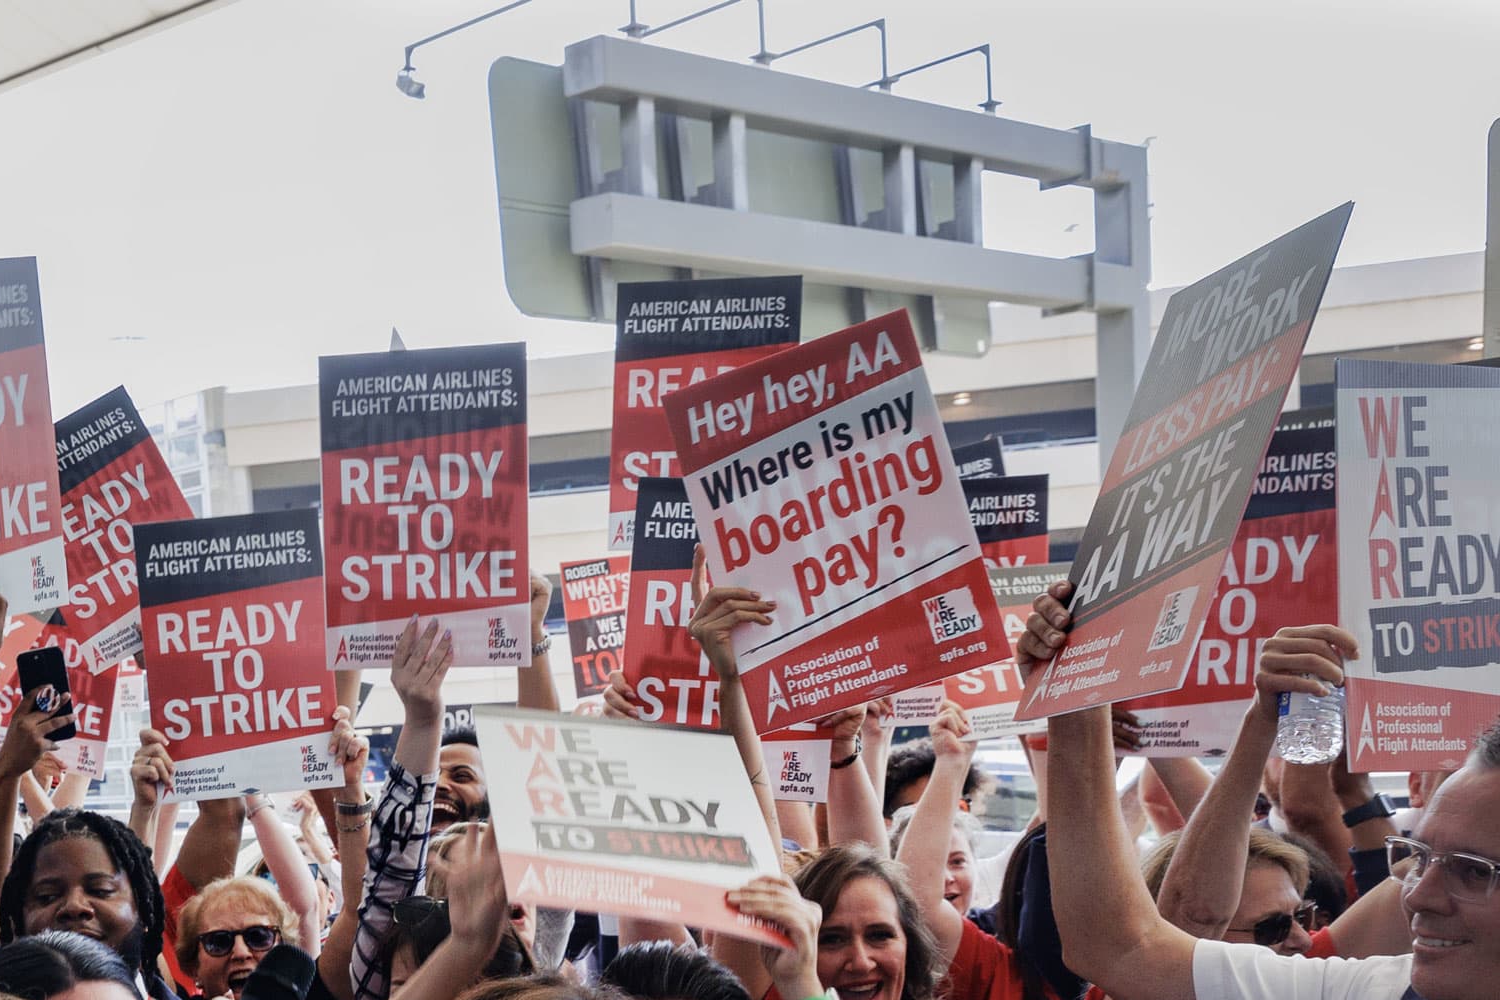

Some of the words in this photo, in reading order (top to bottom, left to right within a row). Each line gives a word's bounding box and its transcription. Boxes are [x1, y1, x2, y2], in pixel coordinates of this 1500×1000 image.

[629, 299, 711, 317] AMERICAN
[714, 296, 786, 313] AIRLINES
[1159, 251, 1268, 367] MORE
[624, 317, 679, 334] FLIGHT
[682, 314, 789, 332] ATTENDANTS:
[1198, 265, 1315, 384] WORK
[337, 374, 428, 396] AMERICAN
[432, 368, 512, 390] AIRLINES
[686, 392, 755, 446] Hey
[766, 363, 837, 415] hey,
[845, 332, 901, 383] AA
[332, 397, 390, 416] FLIGHT
[396, 389, 518, 414] ATTENDANTS:
[1123, 391, 1201, 476] LESS
[1200, 348, 1280, 426] PAY:
[70, 407, 126, 446] AIRLINES
[1358, 396, 1429, 458] WE
[700, 439, 814, 511] Where
[818, 421, 853, 458] is
[861, 390, 915, 441] my
[340, 451, 503, 505] READY
[1108, 462, 1172, 535] IT'S
[1172, 419, 1246, 499] THE
[714, 433, 943, 573] boarding
[970, 494, 1036, 511] AIRLINES
[1369, 457, 1452, 537] ARE
[82, 518, 134, 565] TO
[388, 503, 453, 552] TO
[1068, 534, 1129, 614] AA
[1132, 467, 1242, 578] WAY
[149, 537, 230, 559] AMERICAN
[235, 530, 305, 551] AIRLINES
[146, 561, 202, 578] FLIGHT
[204, 549, 312, 571] ATTENDANTS:
[565, 563, 609, 580] ROBERT,
[793, 505, 906, 616] pay?
[33, 576, 55, 590] READY
[341, 551, 517, 602] STRIKE
[34, 589, 59, 602] apfa.org
[925, 596, 948, 614] WE
[157, 600, 303, 654] READY
[488, 617, 503, 628] WE
[596, 617, 619, 632] WE
[933, 608, 956, 626] ARE
[935, 615, 976, 640] READY
[349, 633, 393, 643] Association
[488, 638, 518, 649] READY
[939, 641, 987, 663] apfa.org
[1060, 638, 1108, 661] Association
[1375, 621, 1414, 657] TO
[488, 650, 522, 661] apfa.org
[783, 647, 862, 678] Association
[865, 636, 880, 652] of
[1054, 651, 1108, 679] Professional
[202, 648, 264, 692] TO
[787, 656, 872, 693] Professional
[1073, 668, 1120, 690] Attendants
[790, 686, 831, 708] Flight
[834, 663, 908, 698] Attendants
[163, 686, 324, 741] STRIKE
[1376, 702, 1436, 717] Association
[1439, 702, 1451, 716] of
[505, 723, 599, 756] WE
[1377, 720, 1442, 733] Professional
[783, 752, 797, 761] WE
[1377, 737, 1407, 752] Flight
[1410, 737, 1467, 751] Attendants
[175, 769, 215, 777] Association
[175, 775, 219, 785] Professional
[302, 763, 328, 772] READY
[303, 773, 332, 783] apfa.org
[526, 751, 636, 789] ARE
[781, 771, 811, 781] READY
[198, 782, 236, 792] Attendants
[780, 783, 814, 794] apfa.org
[526, 786, 720, 829] READY
[539, 825, 594, 849] TO
[607, 831, 749, 863] STRIKE
